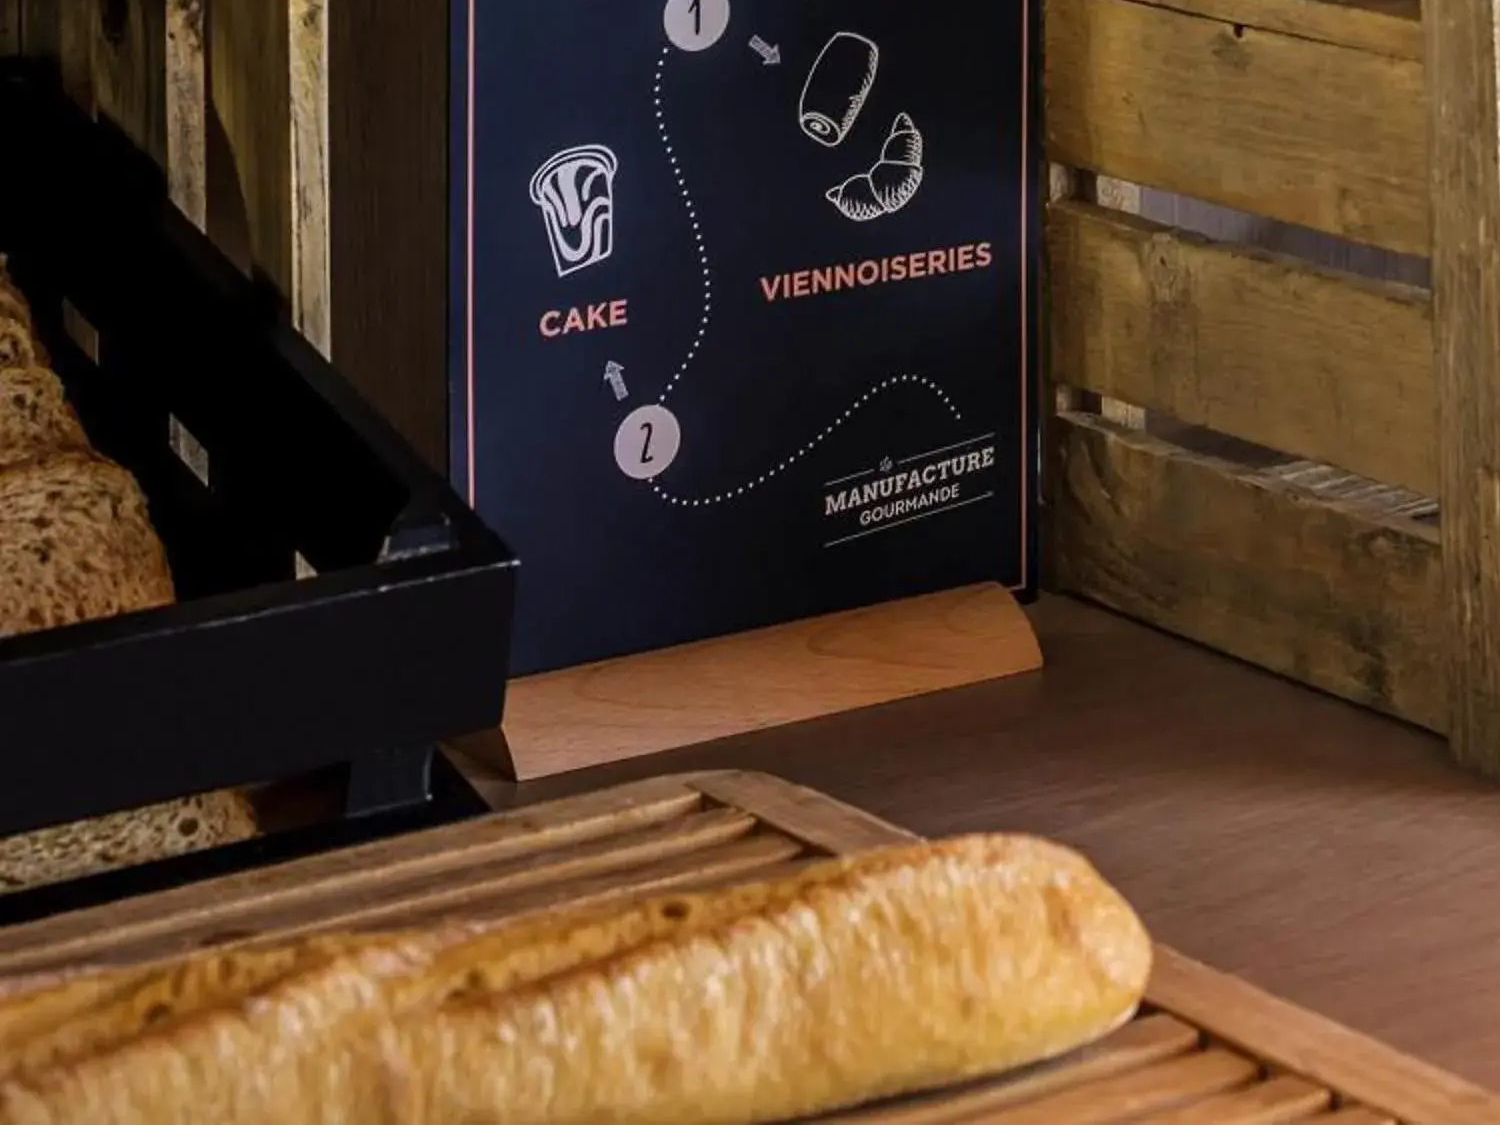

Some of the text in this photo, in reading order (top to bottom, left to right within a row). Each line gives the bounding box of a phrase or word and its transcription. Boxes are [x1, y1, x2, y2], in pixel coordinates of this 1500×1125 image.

[760, 242, 993, 302] VIENNOISERIES
[538, 300, 628, 338] CAKE
[639, 422, 654, 465] 2
[824, 446, 996, 516] MANUFACTURE
[859, 483, 960, 527] GOURMANDE
